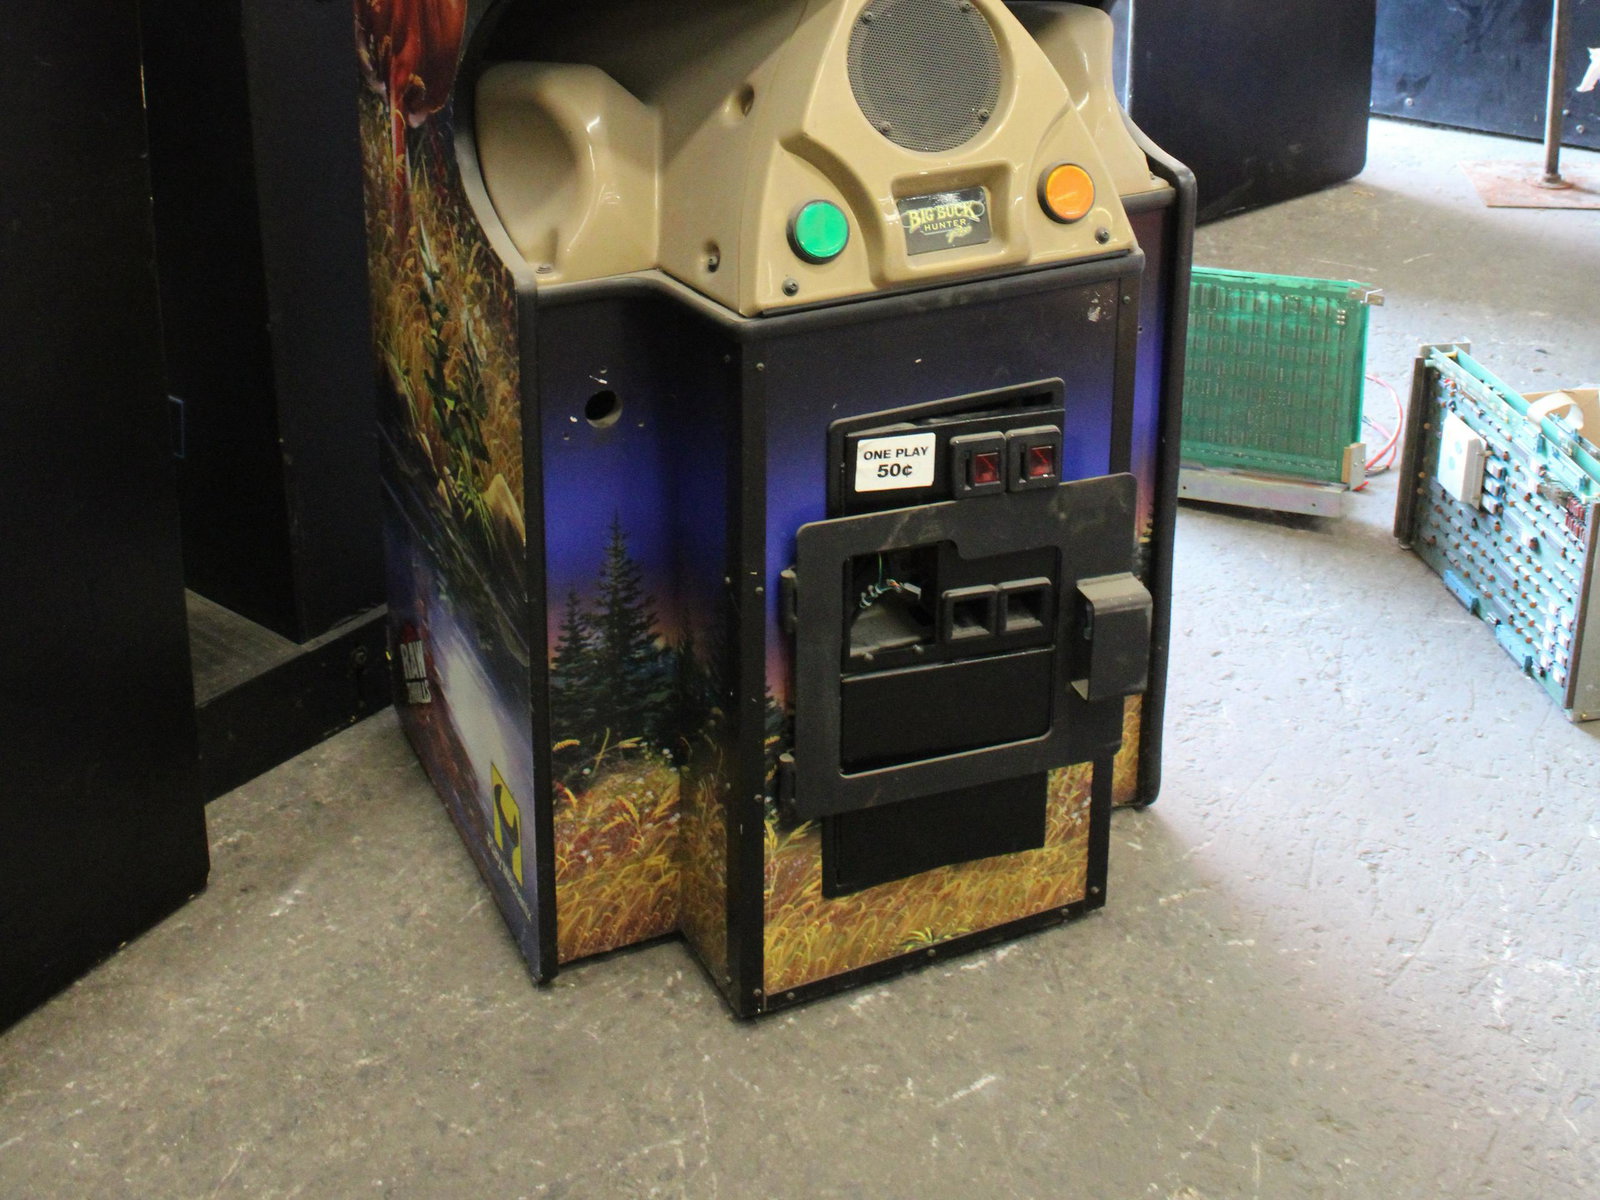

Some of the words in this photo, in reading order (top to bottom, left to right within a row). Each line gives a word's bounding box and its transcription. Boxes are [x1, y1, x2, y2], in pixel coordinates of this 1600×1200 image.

[908, 208, 934, 233] BIG
[934, 200, 980, 222] BUCK
[924, 218, 967, 231] HUNTER
[863, 449, 892, 461] ONE
[895, 446, 929, 459] PLAY
[876, 463, 913, 479] 50¢
